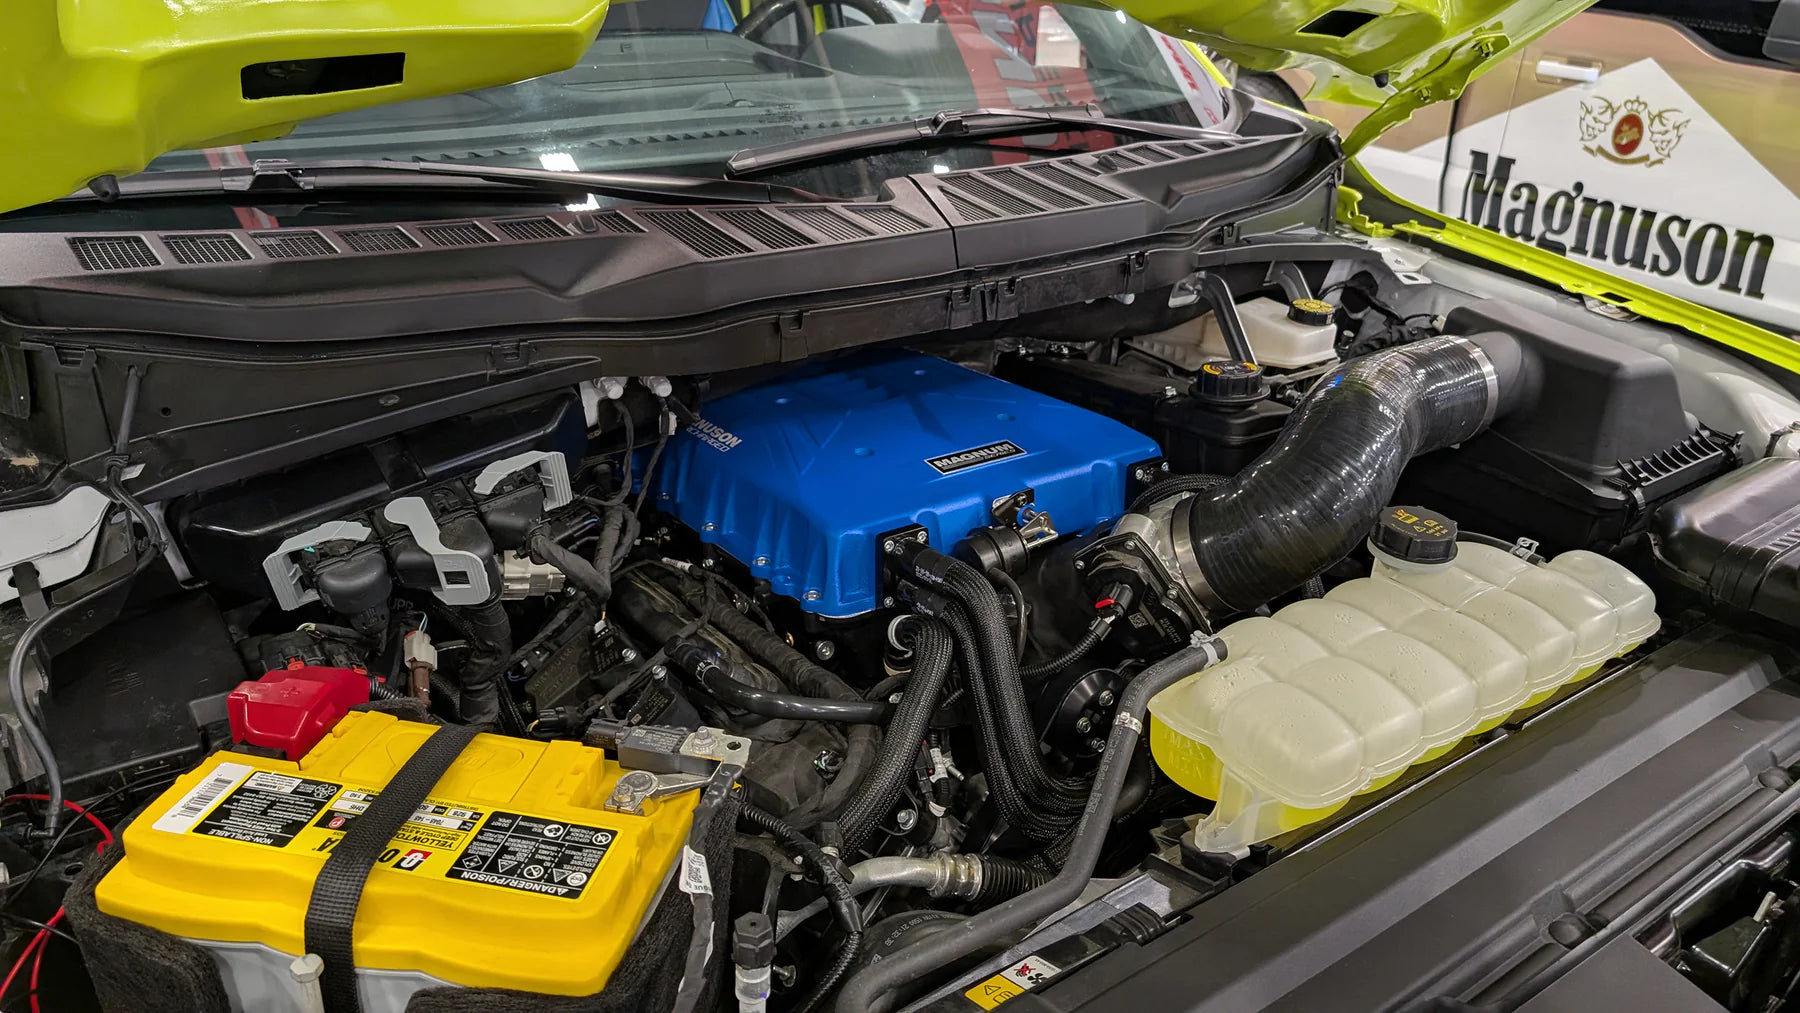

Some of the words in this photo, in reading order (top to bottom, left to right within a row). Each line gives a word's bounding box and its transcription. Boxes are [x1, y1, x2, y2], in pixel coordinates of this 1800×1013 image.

[1458, 149, 1774, 301] Magnuson
[692, 419, 743, 448] NUSON
[933, 443, 1015, 468] MAGNUM
[208, 829, 273, 844] NON-SPILLABLE
[392, 832, 453, 848] YELLOWTO
[461, 871, 556, 893] DANGER/POISON
